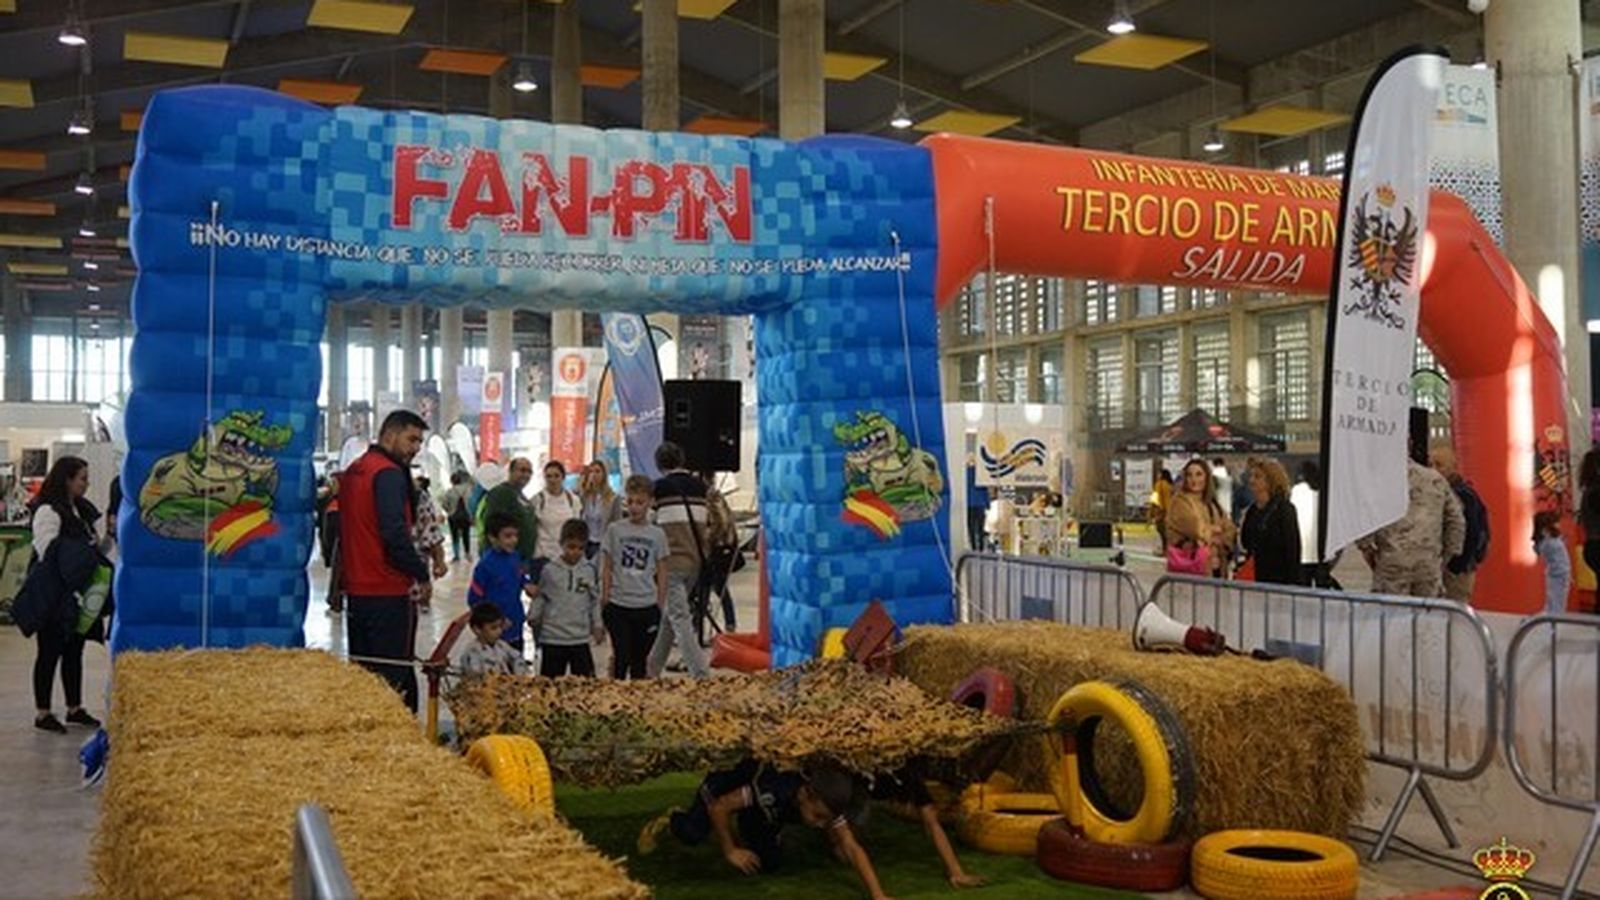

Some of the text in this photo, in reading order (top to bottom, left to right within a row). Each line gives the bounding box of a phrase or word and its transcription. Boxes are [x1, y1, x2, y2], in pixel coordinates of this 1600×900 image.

[1445, 82, 1488, 106] ECA
[390, 144, 754, 242] FAN-PIN
[1248, 174, 1285, 197] DE
[1285, 178, 1341, 200] MAR
[1056, 186, 1337, 248] TERCIO DE AR
[244, 231, 281, 250] HAY
[286, 235, 372, 260] DISTANCIA
[376, 244, 414, 264] QUE
[424, 246, 449, 267] NO
[1172, 246, 1305, 285] SALIDA
[1333, 369, 1409, 397] TERCIO
